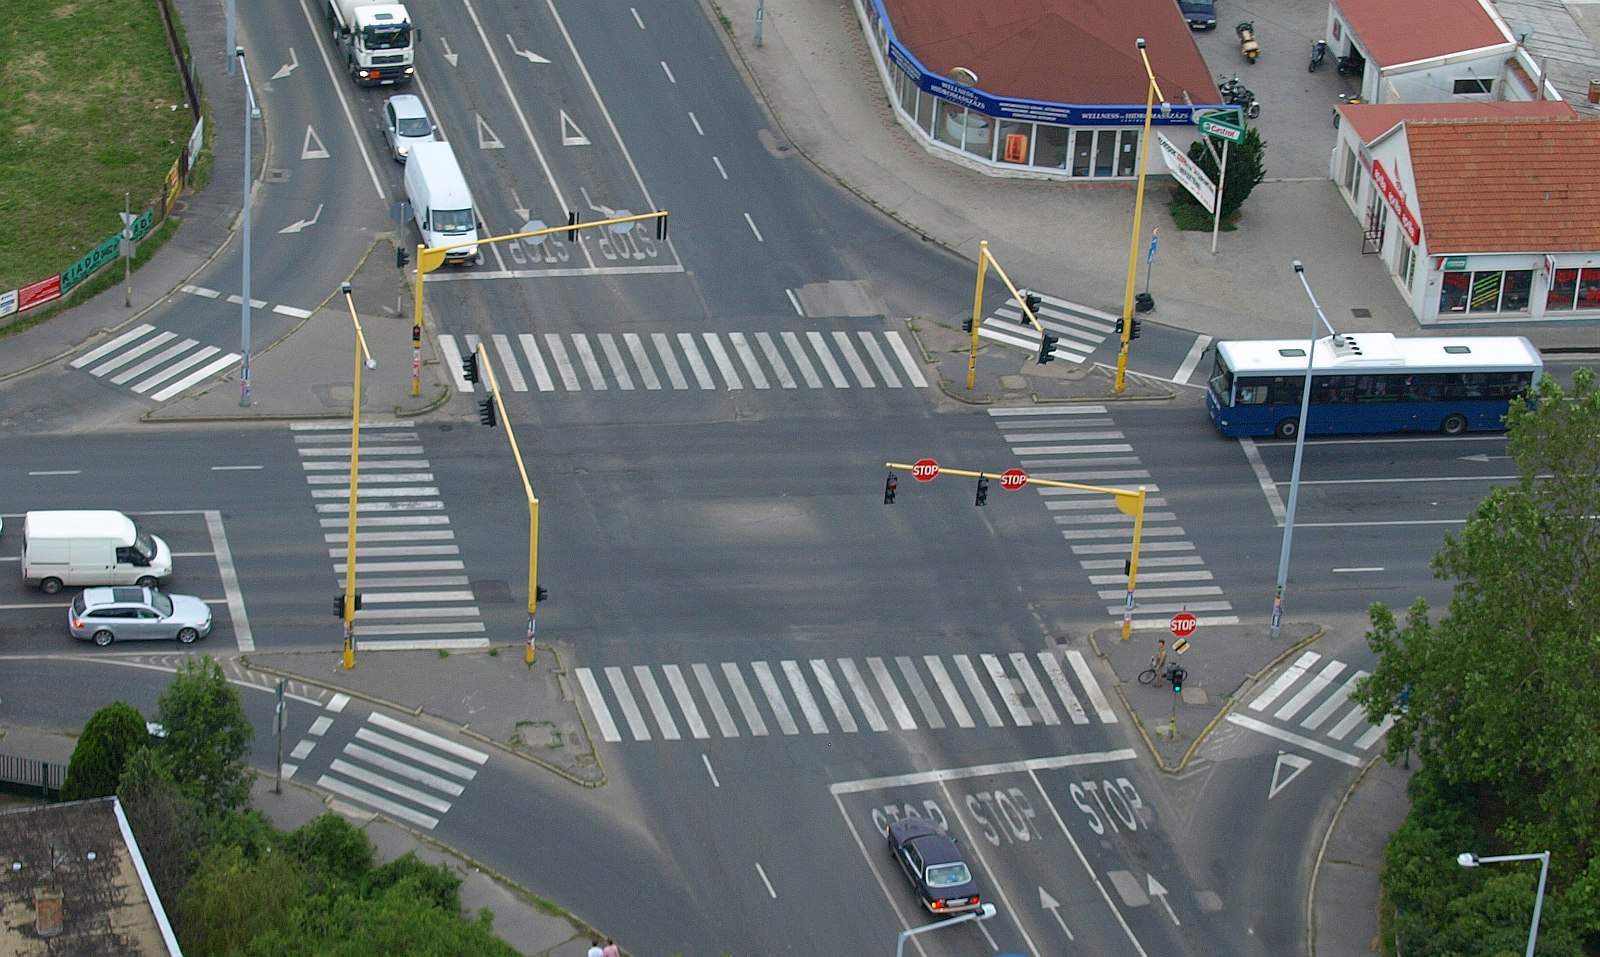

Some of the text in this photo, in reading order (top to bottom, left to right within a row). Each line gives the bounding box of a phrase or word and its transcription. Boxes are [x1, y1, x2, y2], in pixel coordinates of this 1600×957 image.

[1211, 125, 1235, 137] Castrol
[912, 465, 939, 476] STOP
[1000, 475, 1027, 485] STOP
[1170, 619, 1196, 631] STOP
[1069, 777, 1148, 835] STOP
[965, 787, 1043, 847] STOP
